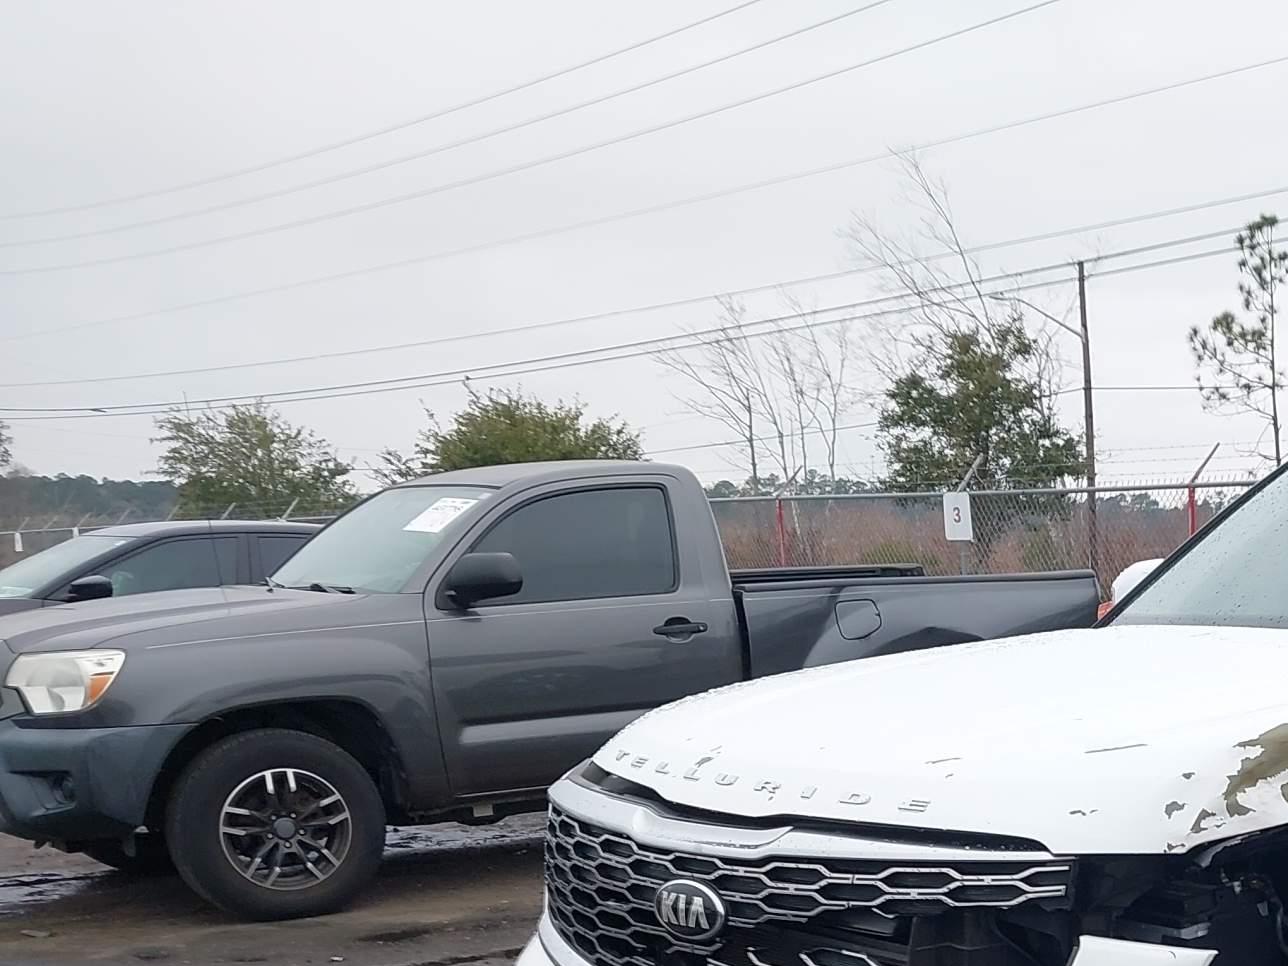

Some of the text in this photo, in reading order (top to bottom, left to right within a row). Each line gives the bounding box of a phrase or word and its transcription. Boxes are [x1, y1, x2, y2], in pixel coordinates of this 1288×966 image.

[952, 506, 961, 524] 3
[615, 748, 932, 813] TELLURIDE
[661, 890, 710, 929] KIA
